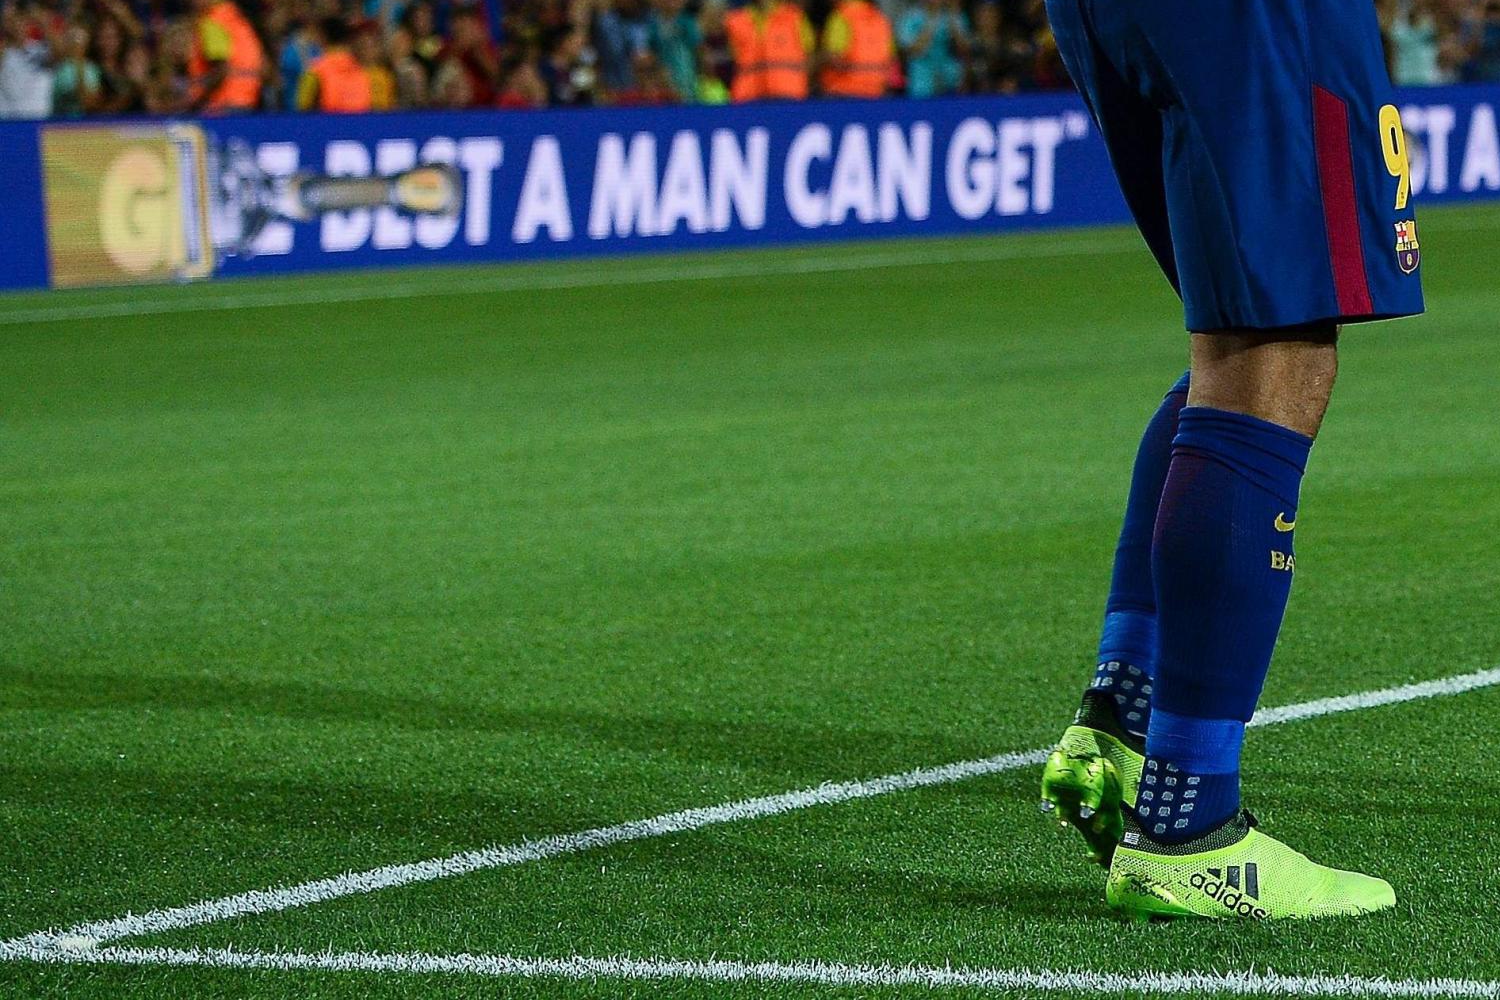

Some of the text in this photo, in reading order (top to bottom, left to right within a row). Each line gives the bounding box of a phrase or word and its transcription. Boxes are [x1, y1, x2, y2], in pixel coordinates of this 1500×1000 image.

[511, 134, 574, 244] A
[587, 126, 771, 241] MAN
[783, 119, 934, 230] CAN
[1378, 104, 1409, 210] 9
[1271, 550, 1297, 574] BA
[1190, 872, 1268, 920] adidas
